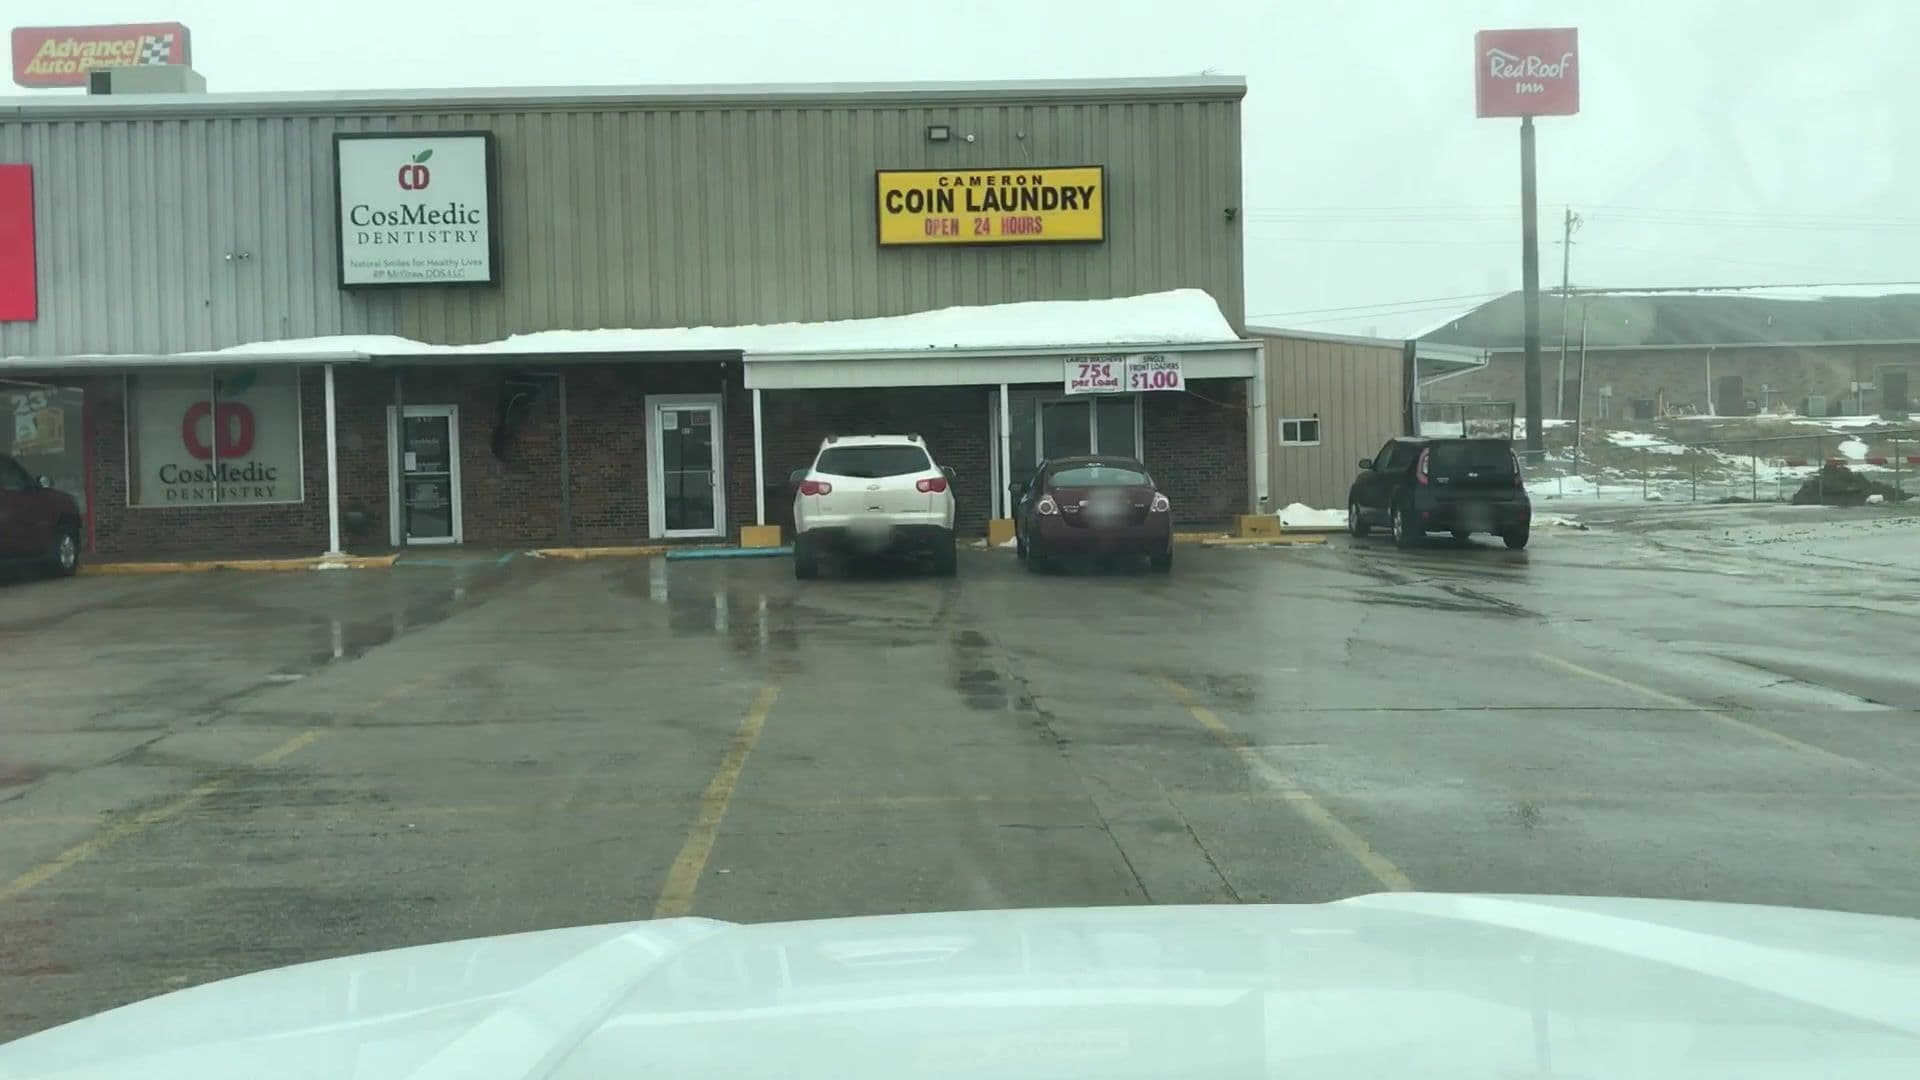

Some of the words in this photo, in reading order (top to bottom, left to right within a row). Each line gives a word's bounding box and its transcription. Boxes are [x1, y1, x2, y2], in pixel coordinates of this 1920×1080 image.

[36, 37, 135, 57] Advance
[24, 56, 76, 74] Auto
[398, 164, 430, 190] CD
[938, 174, 1044, 187] CAMERON
[886, 188, 955, 214] COIN
[966, 186, 1096, 213] LAUNDRY
[350, 202, 481, 226] CosMedic
[925, 218, 960, 237] OPEN
[974, 217, 991, 236] 24
[1001, 216, 1043, 235] HOURS
[358, 230, 479, 245] DENTISTRY
[350, 258, 381, 268] Natural
[384, 258, 410, 267] Smiles
[412, 258, 424, 267] for
[427, 258, 458, 268] Healthy
[461, 258, 483, 267] Lives
[1071, 379, 1090, 389] per
[1091, 377, 1118, 387] Load
[1131, 371, 1178, 389] $1.00
[159, 462, 278, 485] CosMedic
[166, 486, 276, 501] DENTISTRY
